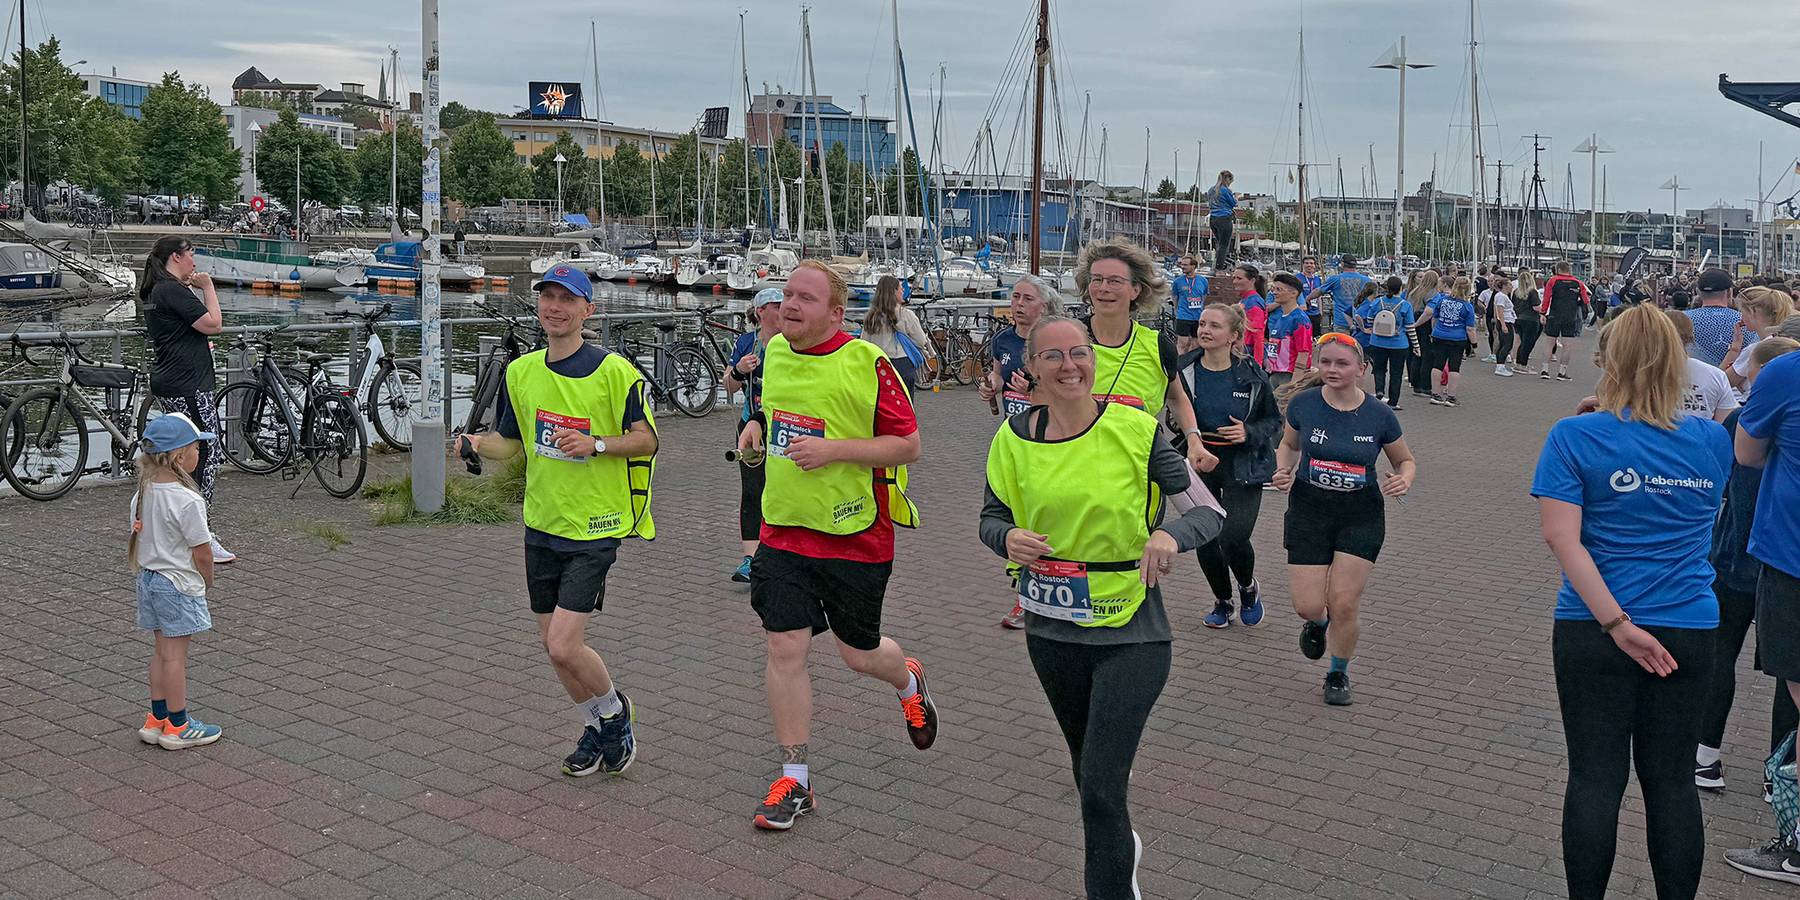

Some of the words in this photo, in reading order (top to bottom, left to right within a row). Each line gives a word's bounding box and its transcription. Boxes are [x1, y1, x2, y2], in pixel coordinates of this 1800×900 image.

[1233, 391, 1250, 399] RWE
[1353, 435, 1374, 443] RWE
[1318, 473, 1355, 489] 635
[1644, 475, 1714, 489] Lebenshilfe
[1644, 485, 1673, 496] Rostock
[832, 506, 853, 519] BAUEN
[853, 502, 864, 512] MV
[588, 520, 612, 530] BAUEN
[612, 517, 621, 526] MV
[1039, 573, 1071, 584] Rostock
[1027, 579, 1074, 607] 670
[1081, 598, 1088, 607] 1
[1107, 605, 1123, 615] MV
